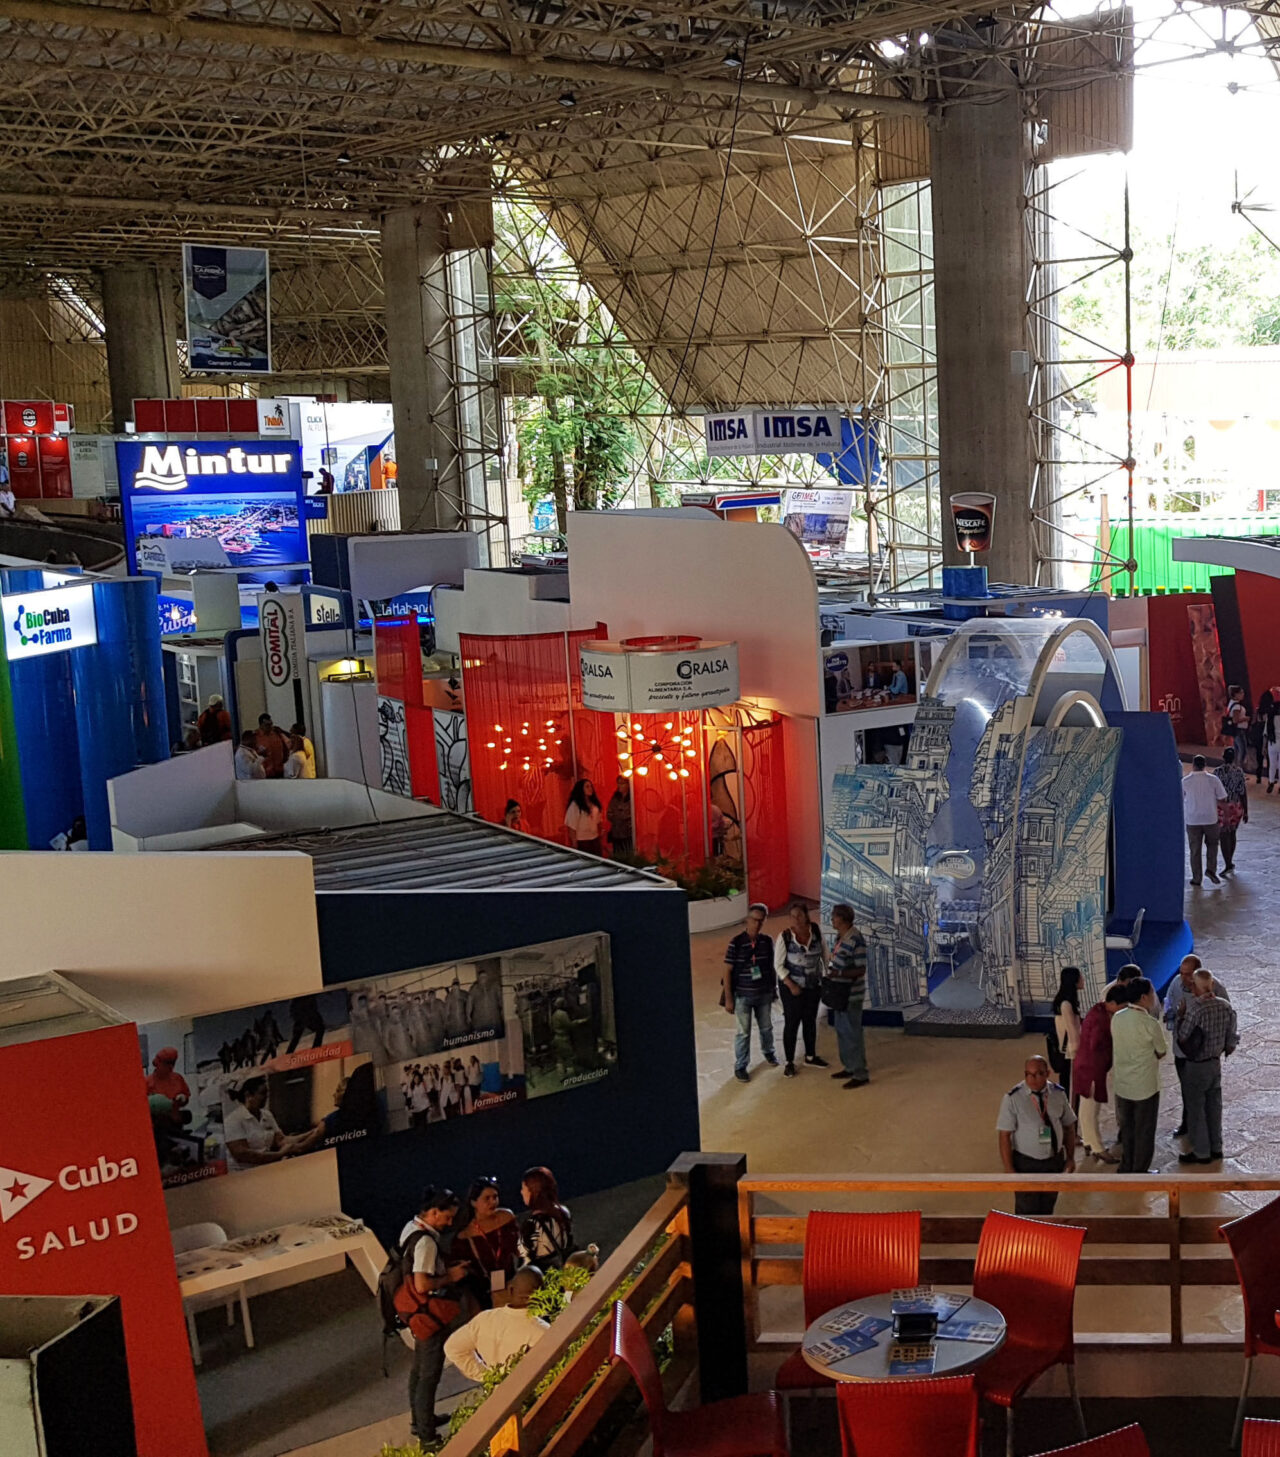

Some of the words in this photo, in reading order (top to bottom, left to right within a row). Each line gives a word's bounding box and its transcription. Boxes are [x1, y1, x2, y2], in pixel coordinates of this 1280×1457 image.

[709, 418, 748, 441] IMSA
[764, 416, 832, 438] IMSA
[143, 446, 291, 475] Mintur
[26, 607, 70, 629] BioCuba
[39, 626, 72, 645] Farma
[267, 608, 283, 677] COMITAL
[443, 1028, 495, 1047] humanismo
[286, 1046, 341, 1065] solidaridad
[563, 1068, 609, 1087] producción
[473, 1091, 517, 1109] formación
[323, 1128, 367, 1146] servicios
[58, 1155, 139, 1191] Cuba
[16, 1212, 139, 1260] SALUD
